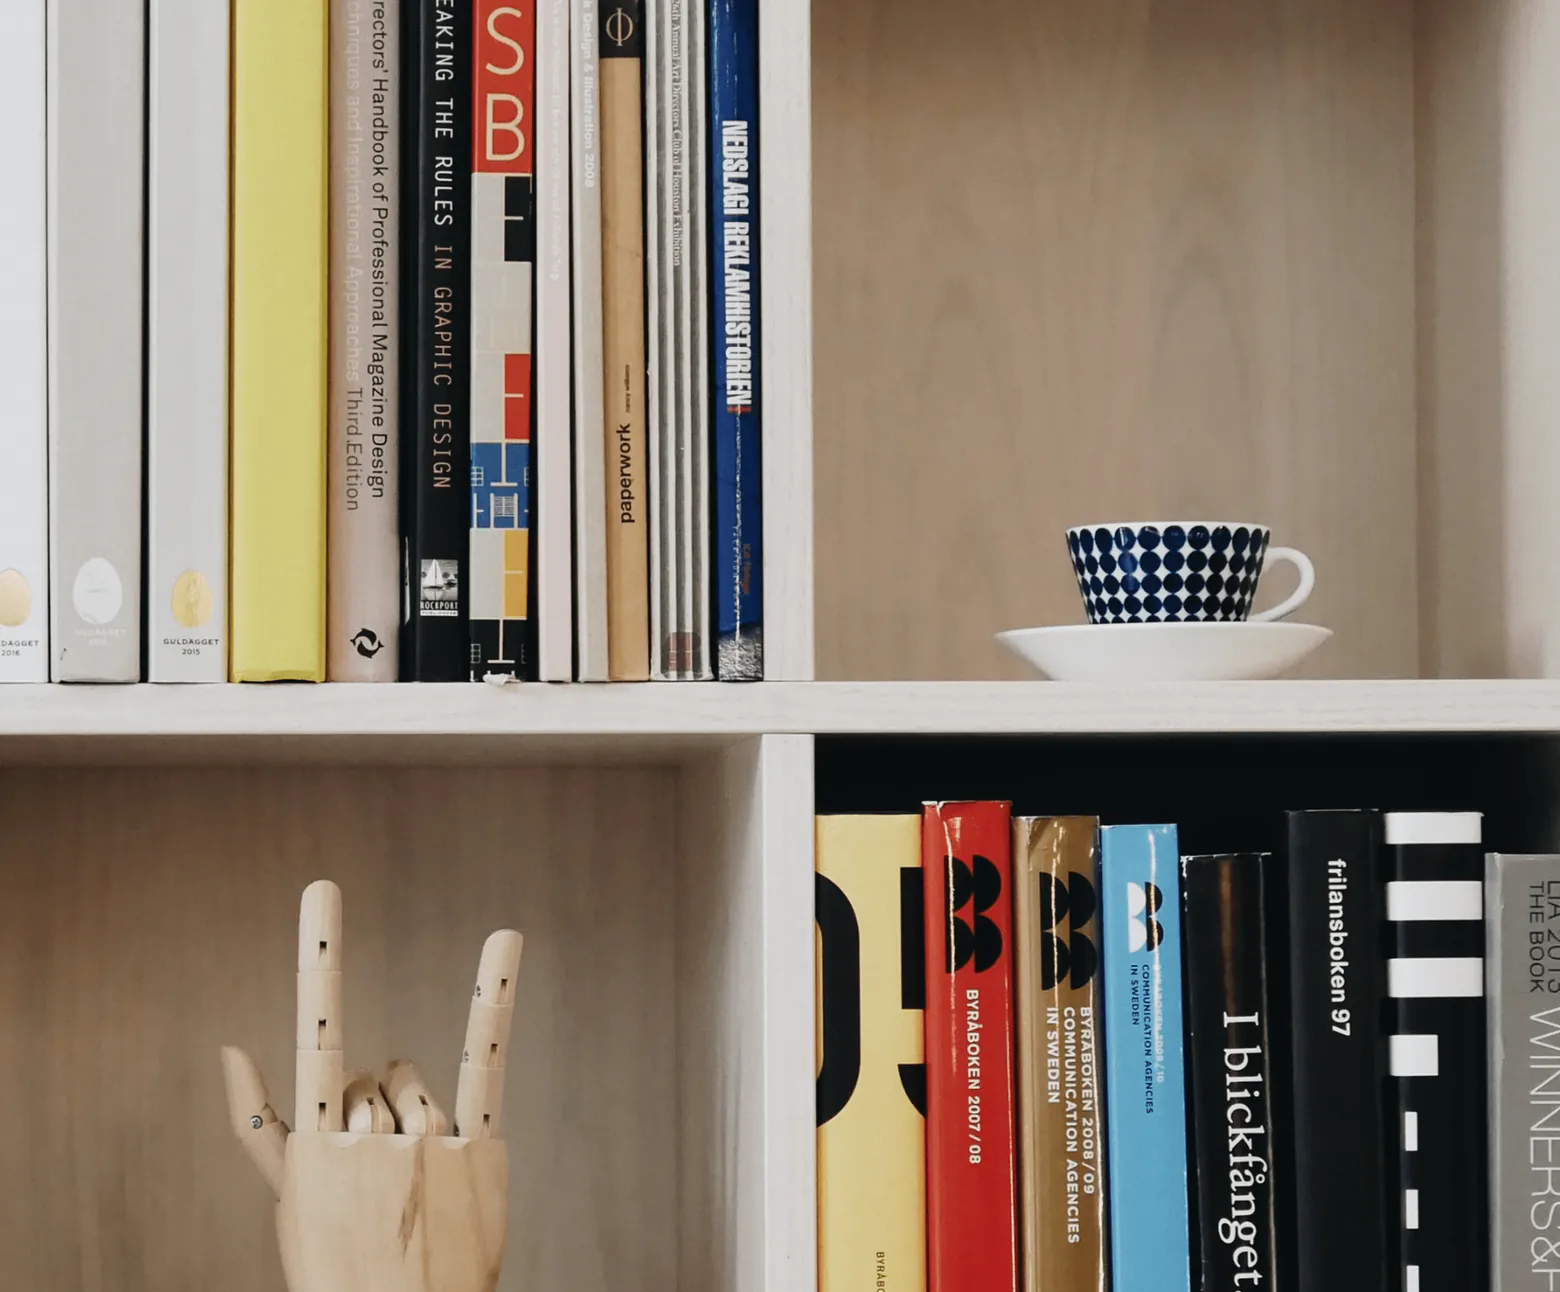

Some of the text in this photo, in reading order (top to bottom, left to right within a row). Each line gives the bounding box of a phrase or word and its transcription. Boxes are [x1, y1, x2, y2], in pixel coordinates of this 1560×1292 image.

[581, 13, 593, 60] Design
[672, 24, 681, 60] Annual
[583, 63, 593, 73] &
[672, 63, 681, 79] Art
[347, 97, 363, 130] and
[372, 79, 388, 176] Handbook
[434, 98, 453, 139] THE
[583, 75, 594, 149] Illustration
[672, 82, 682, 128] Directors
[584, 153, 595, 188] 2008
[672, 130, 683, 154] Club
[344, 138, 363, 260] Inspirational
[372, 182, 389, 202] of
[434, 156, 453, 226] RULES
[673, 169, 682, 212] Houston
[372, 208, 388, 327] Professional
[433, 244, 452, 270] IN
[673, 215, 683, 266] Exhibition
[343, 266, 363, 381] Approaches
[433, 286, 452, 386] GRAPHIC
[724, 222, 751, 412] REKLAMHISTORIEN!
[367, 334, 388, 426] Magazine
[346, 388, 363, 436] Third
[367, 434, 388, 498] Design
[433, 403, 451, 488] DESIGN
[616, 423, 635, 524] paperwork
[346, 443, 362, 511] Edition
[420, 601, 458, 610] ROCKPORT
[163, 637, 220, 646] GULDÄGGET
[182, 647, 200, 656] 2015
[1327, 859, 1351, 1037] frilansboken 97
[1529, 881, 1545, 993] THE BOOK
[1130, 964, 1139, 1025] IN SWEDEN
[1223, 1011, 1260, 1028] I
[966, 989, 983, 1090] BYRÅBOKEN
[1047, 1007, 1061, 1103] IN SWEDEN
[1141, 964, 1153, 1114] COMMUNICATION AGENCIES
[1064, 1007, 1080, 1244] COMMUNICATION AGENCIES
